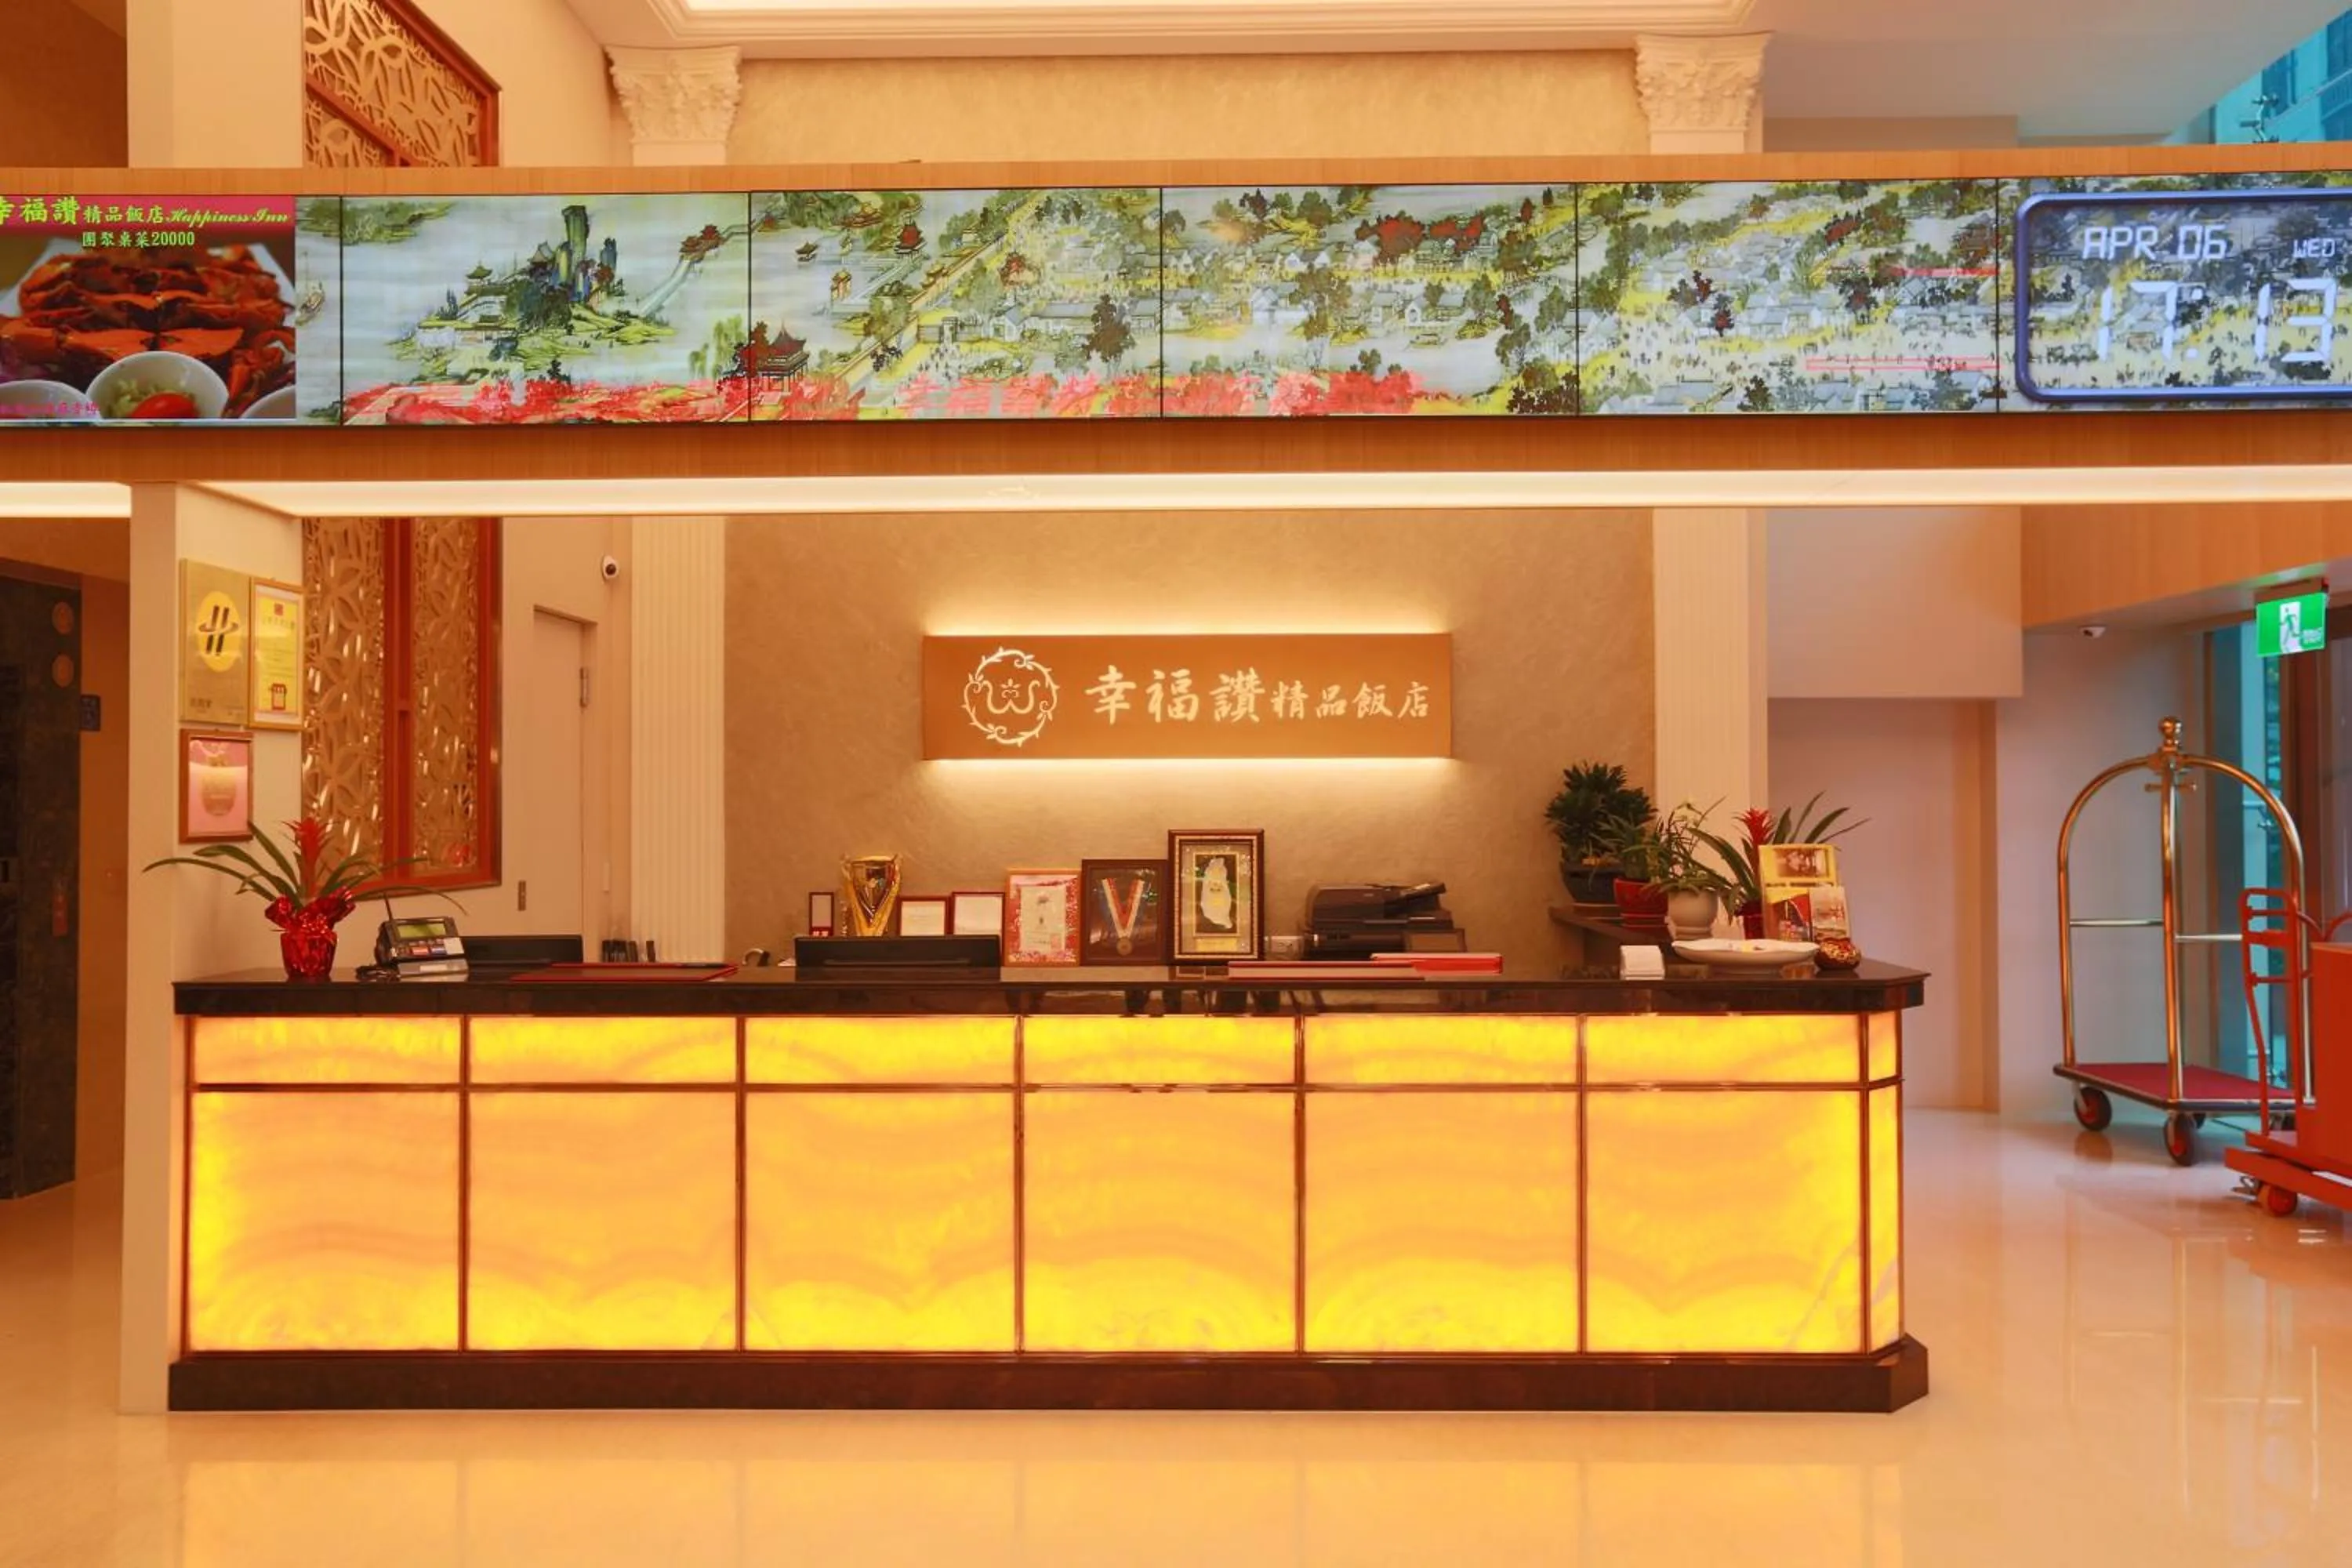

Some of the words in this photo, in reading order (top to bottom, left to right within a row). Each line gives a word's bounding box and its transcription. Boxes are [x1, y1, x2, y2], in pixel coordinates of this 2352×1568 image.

[166, 207, 251, 228] Happiness
[252, 207, 289, 223] Inn
[2082, 226, 2158, 260] APR
[2177, 224, 2227, 260] 06
[2292, 237, 2336, 259] WED
[2097, 278, 2336, 363] 17:13
